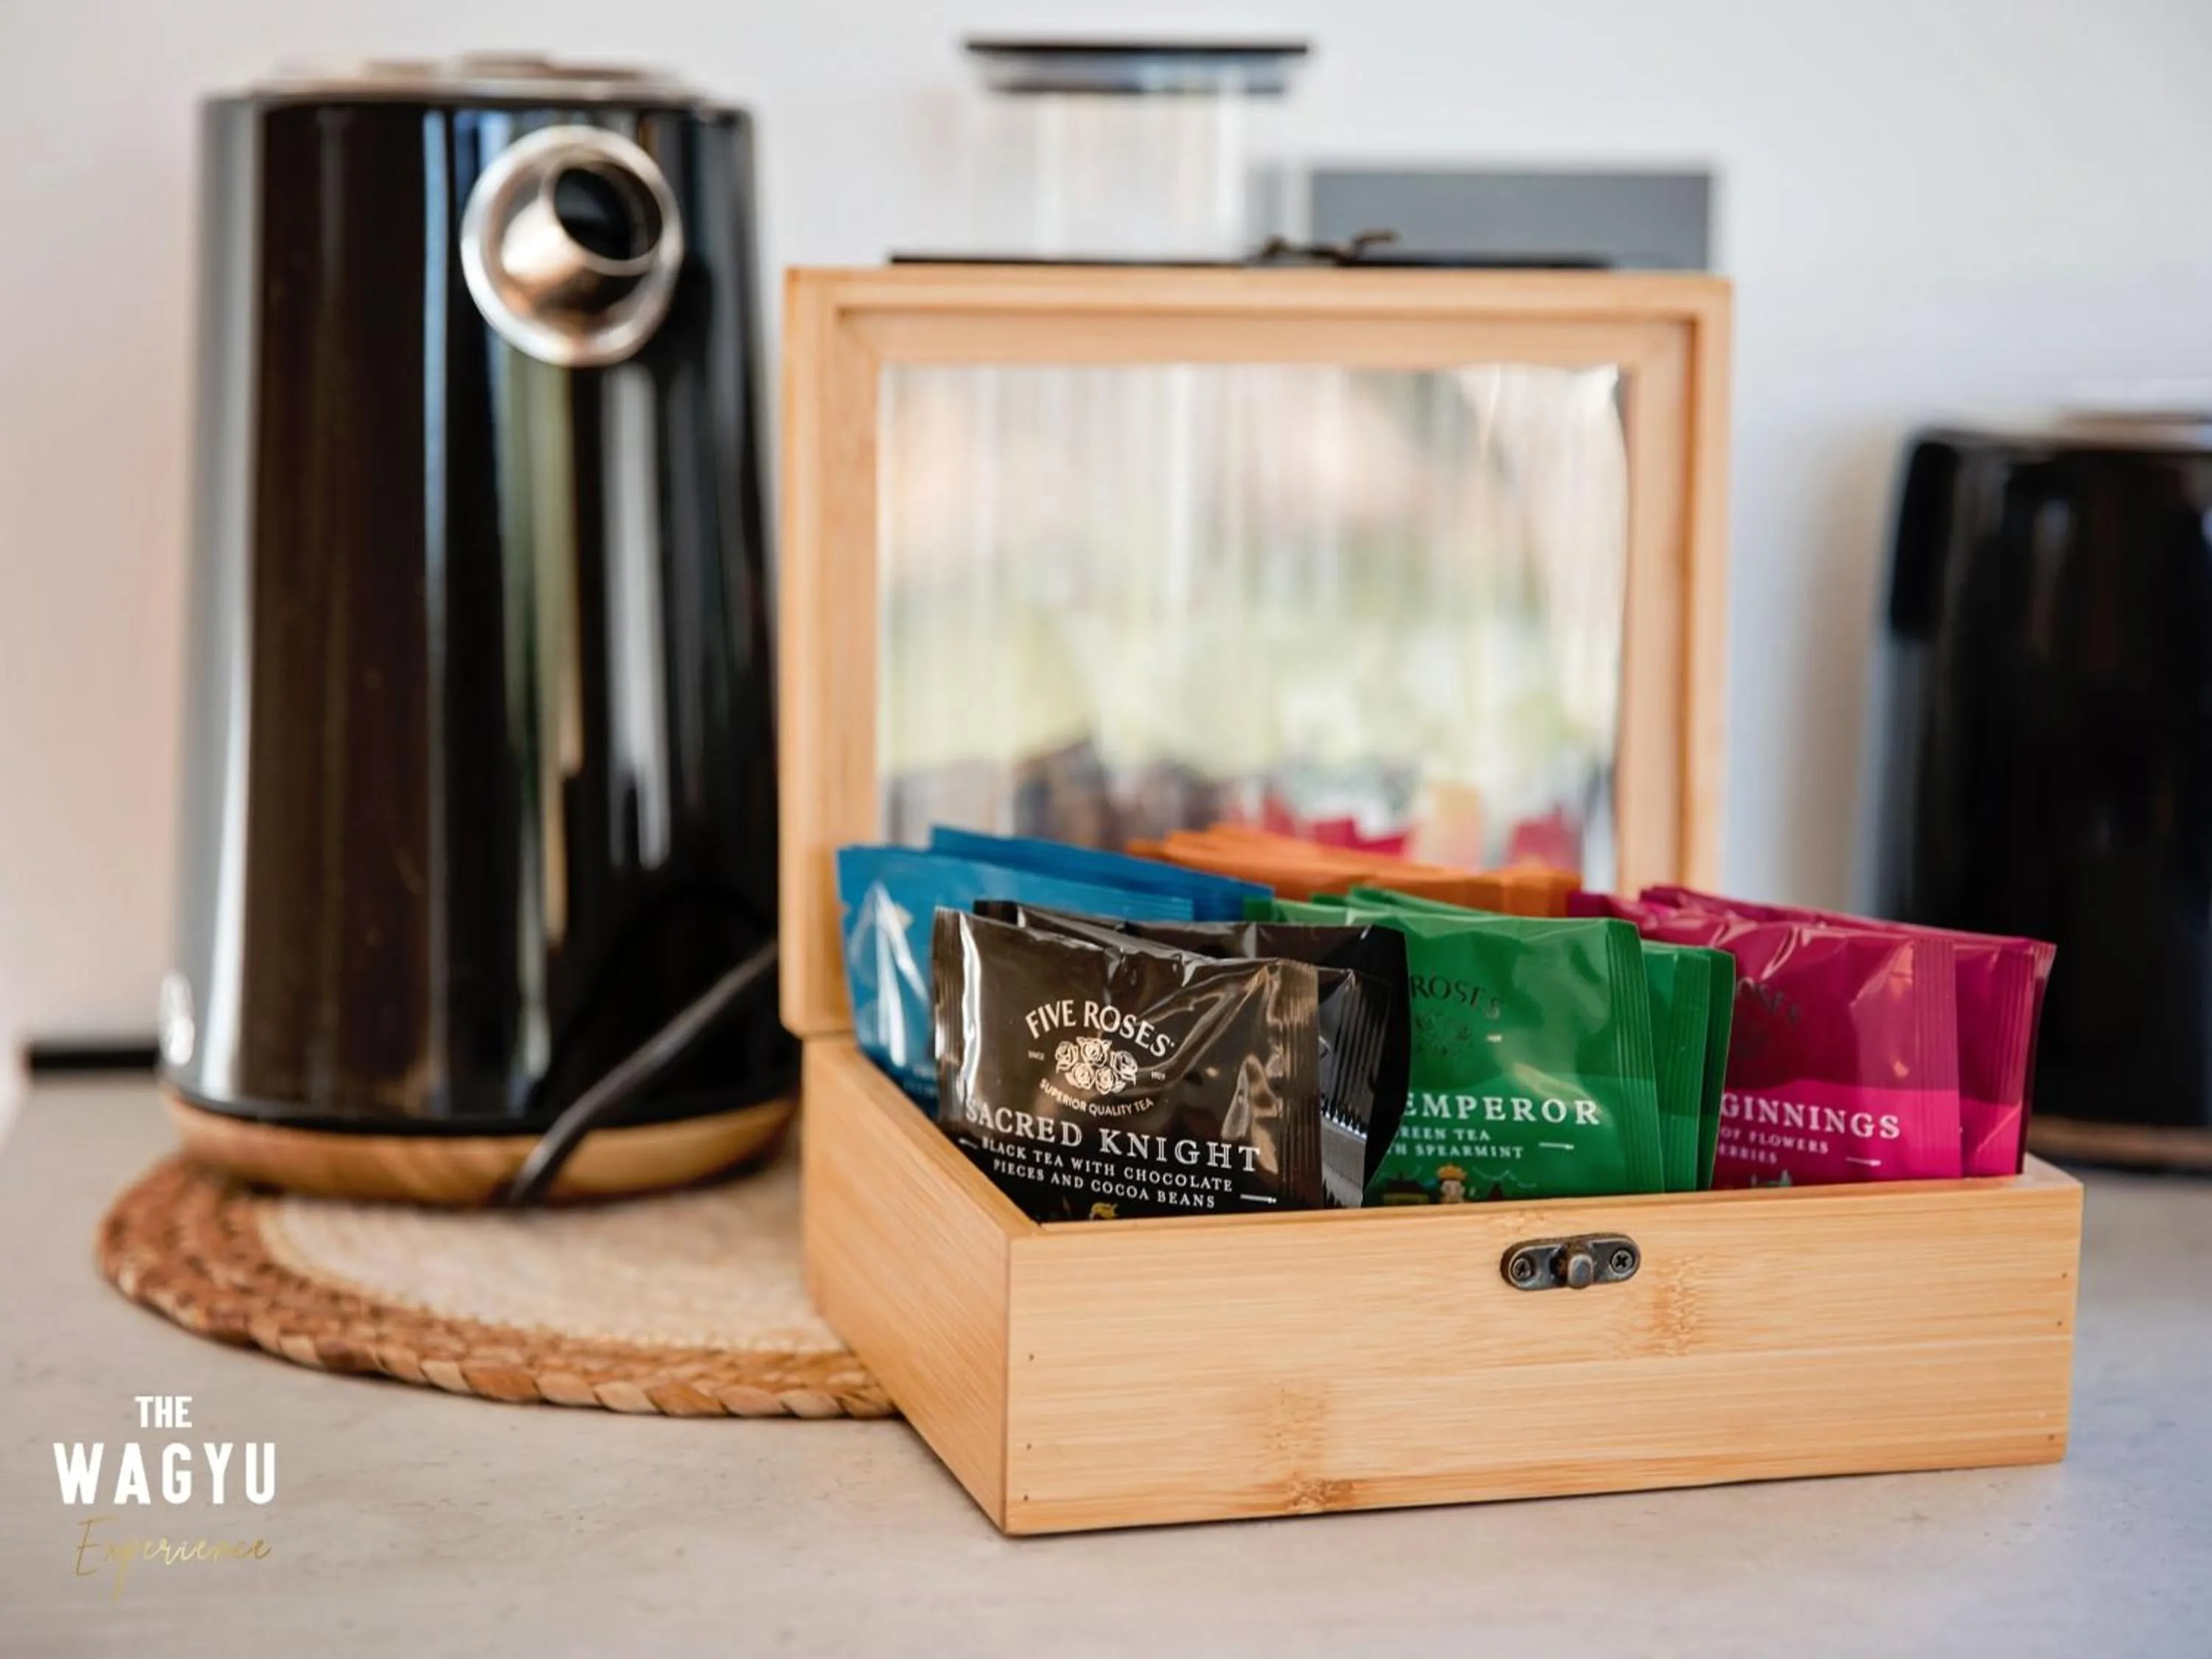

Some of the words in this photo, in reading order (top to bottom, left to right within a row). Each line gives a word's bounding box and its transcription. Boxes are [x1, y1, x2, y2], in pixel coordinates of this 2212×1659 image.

[1025, 1000, 1077, 1039] FIVE
[1084, 1001, 1171, 1057] ROSES
[1040, 1078, 1087, 1112] SUPERIOR
[1088, 1103, 1132, 1116] QUALITY
[1131, 1098, 1154, 1111] TEA
[1721, 1092, 1900, 1139] GINNINGS
[965, 1100, 1083, 1147] SACRED
[1099, 1127, 1260, 1172] KNIGHT
[1401, 1126, 1447, 1140] REEN
[1453, 1129, 1491, 1141] TEA
[1415, 1144, 1523, 1159] SPEARMINT
[1718, 1143, 1778, 1164] ERRIES
[1749, 1130, 1829, 1155] FLOWERS
[981, 1136, 1026, 1160] BLACK
[1033, 1150, 1063, 1167] TEA
[1071, 1157, 1115, 1177] WITH
[1124, 1166, 1232, 1192] CHOCOLATE
[993, 1158, 1044, 1182] PIECES
[1051, 1171, 1083, 1189] AND
[1091, 1180, 1150, 1201] COCOA
[1157, 1190, 1215, 1209] BEANS
